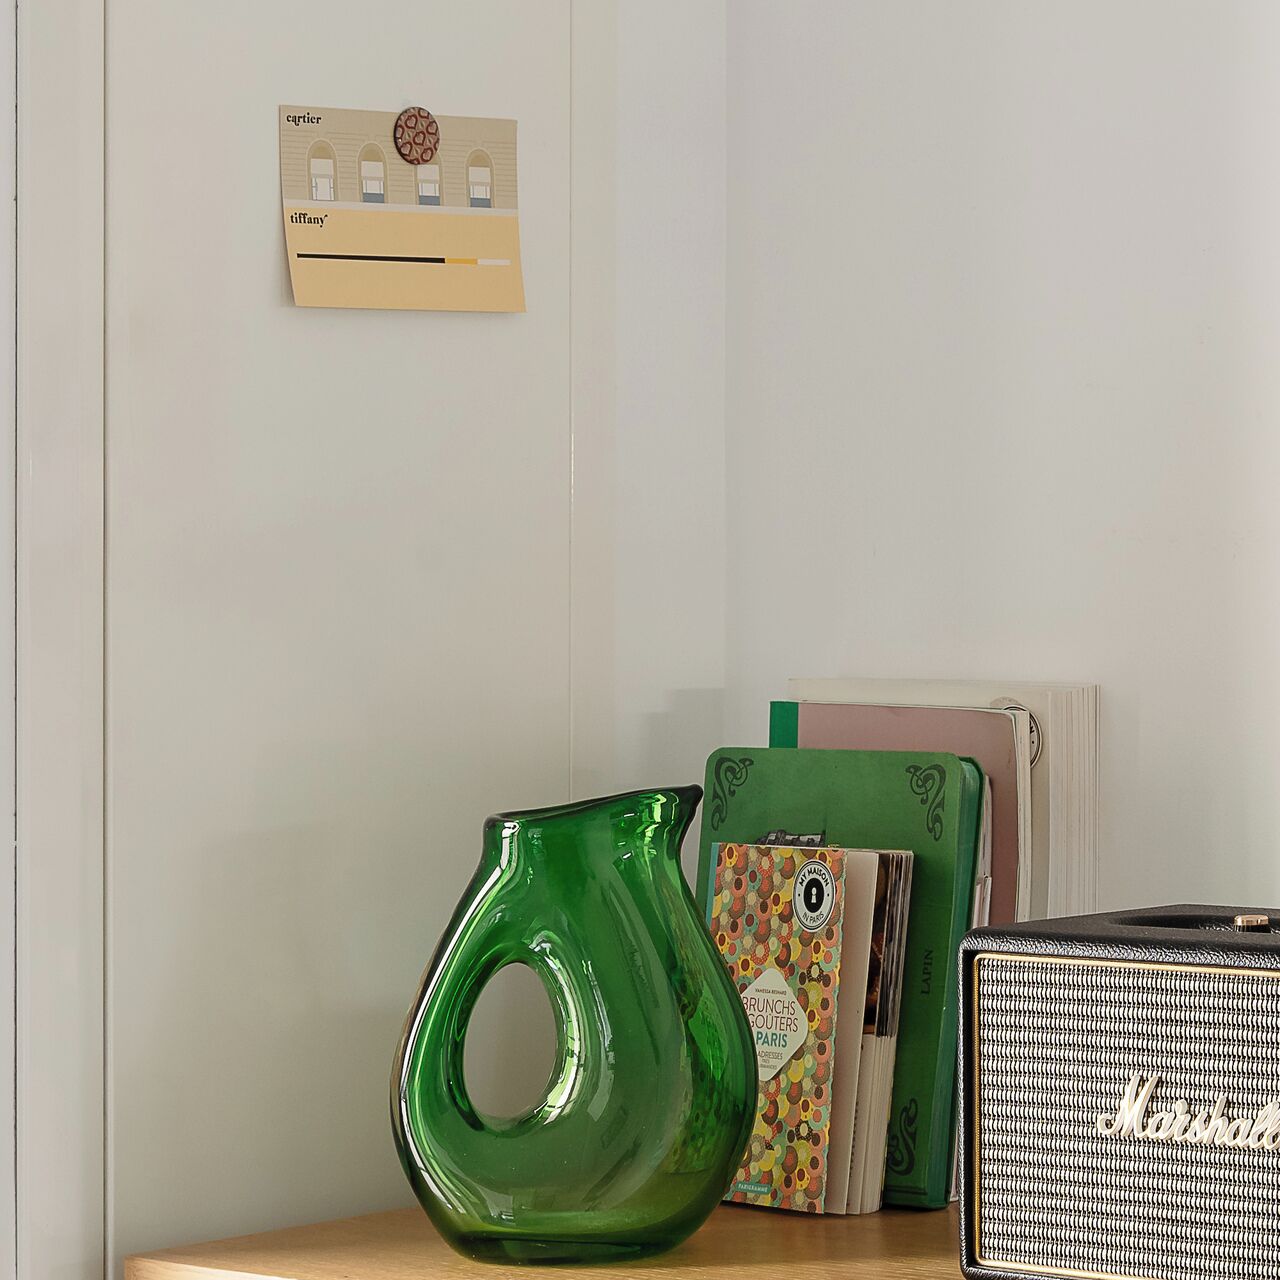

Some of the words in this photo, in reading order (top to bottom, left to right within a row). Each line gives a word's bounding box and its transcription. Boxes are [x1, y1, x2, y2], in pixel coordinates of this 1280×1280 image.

[290, 212, 329, 228] tiffany
[798, 871, 807, 887] MY
[807, 866, 830, 888] MAISON
[802, 911, 810, 922] IN
[810, 910, 824, 924] PARIS
[920, 949, 934, 994] LAPIN
[742, 996, 796, 1016] BRUNCHS
[756, 1031, 788, 1048] PARIS
